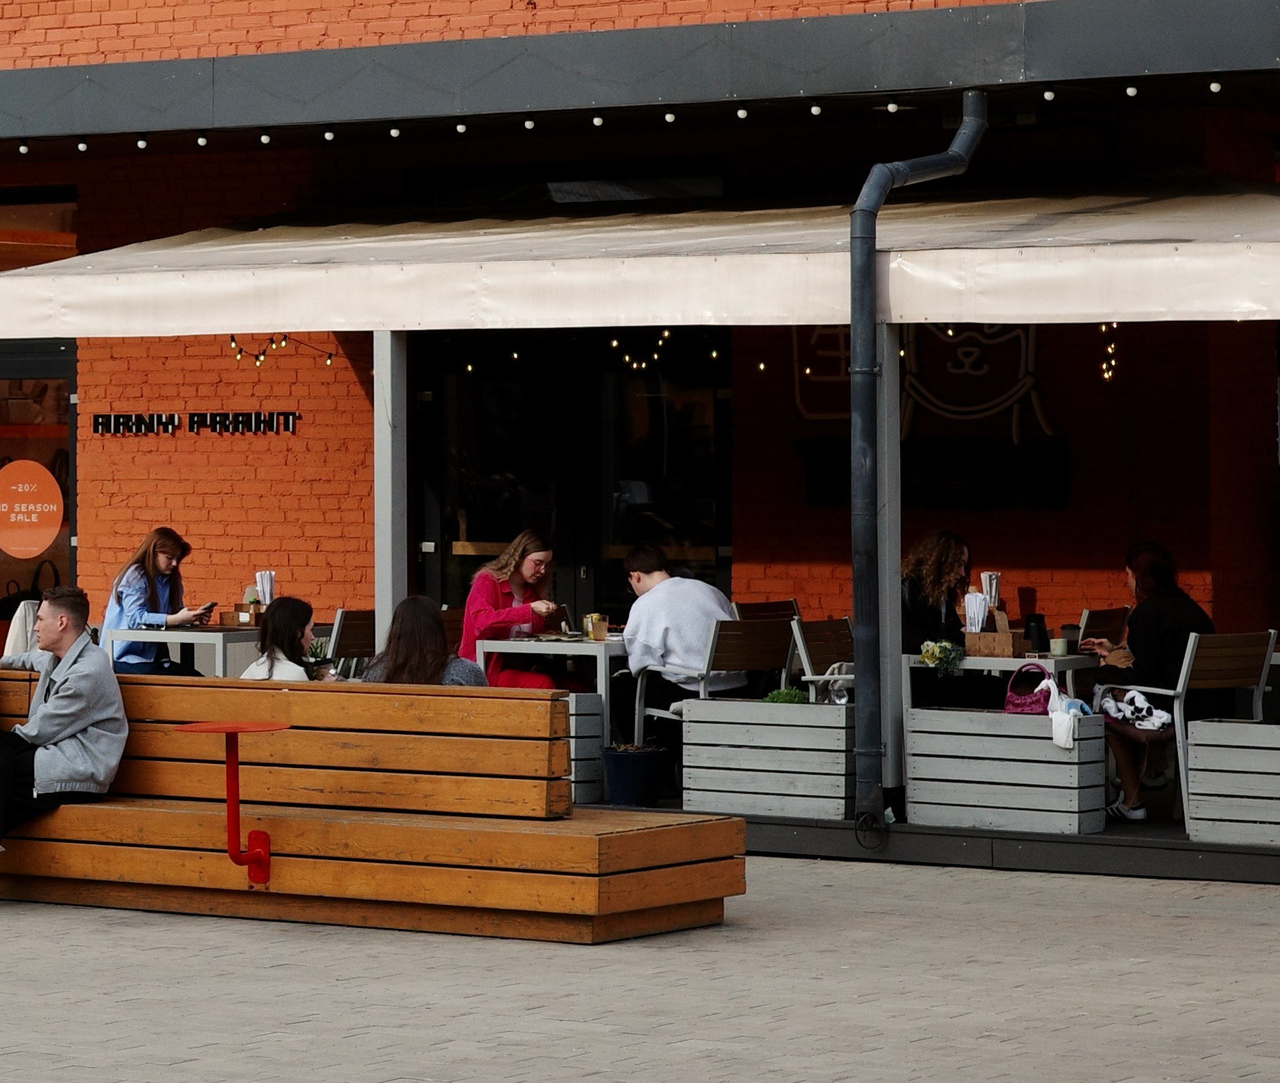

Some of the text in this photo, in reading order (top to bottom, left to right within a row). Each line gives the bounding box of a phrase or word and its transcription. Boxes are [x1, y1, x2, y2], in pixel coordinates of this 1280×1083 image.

[93, 411, 300, 434] ARNY PRAHT
[10, 483, 37, 492] -20%
[14, 503, 57, 512] SEASON
[9, 513, 38, 522] SALE
